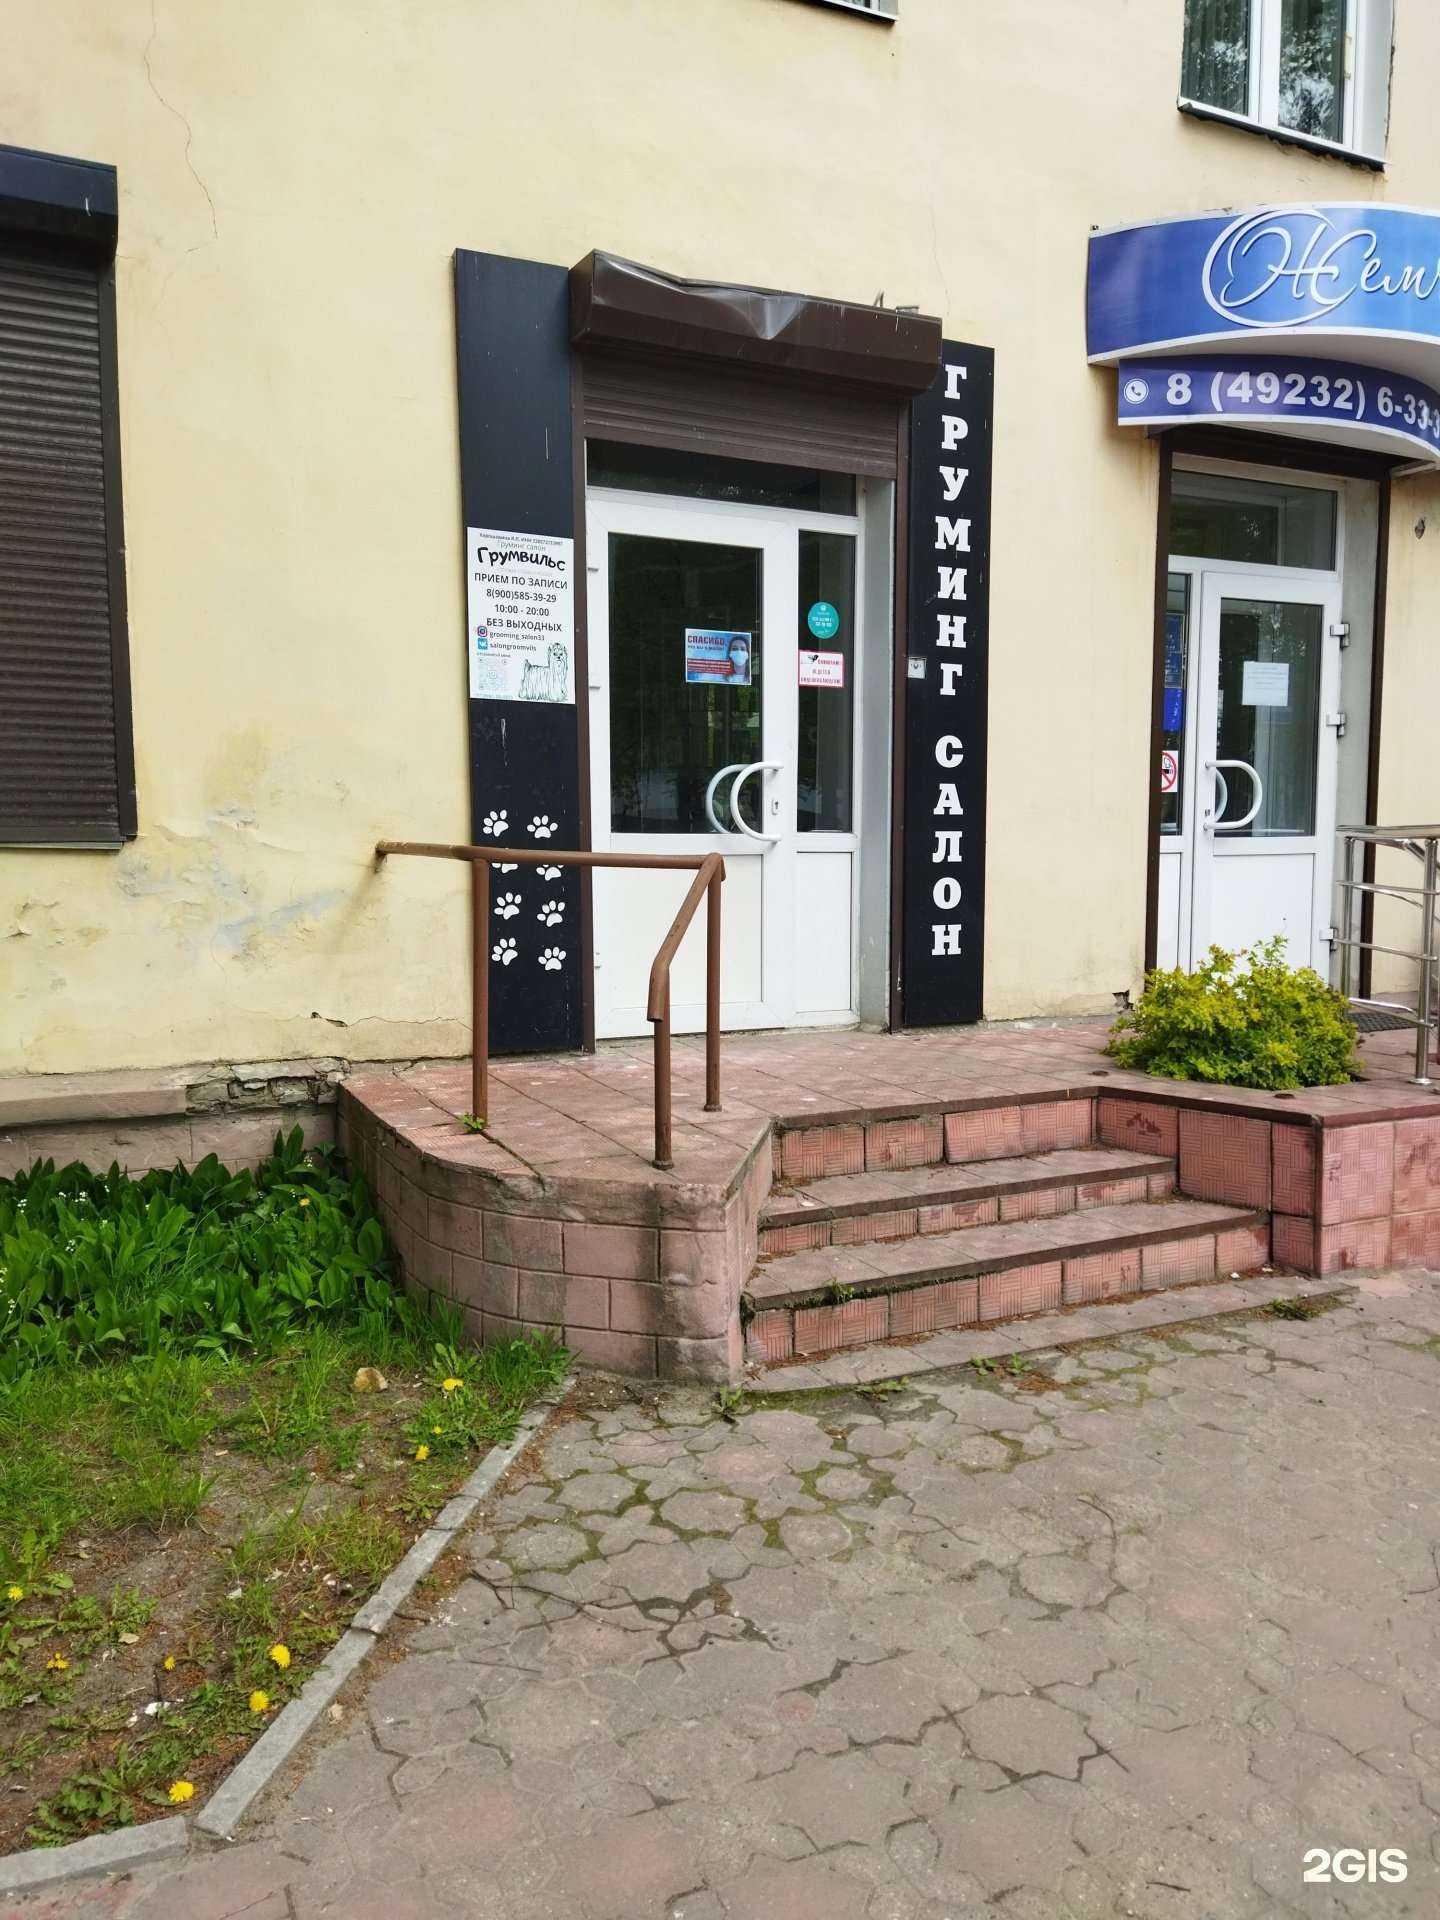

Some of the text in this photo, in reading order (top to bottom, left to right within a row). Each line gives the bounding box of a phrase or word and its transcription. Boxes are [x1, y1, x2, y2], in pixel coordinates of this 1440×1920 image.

[1165, 372, 1193, 406] 8
[1210, 370, 1367, 420] (49232)
[477, 546, 566, 571] Грумвильс
[474, 572, 509, 584] ПРИЕМ
[511, 576, 526, 586] ПО
[528, 578, 568, 589] ЗАПИСИ
[486, 588, 557, 603] 8(900)585-39-29
[495, 604, 518, 614] 10:00
[526, 607, 550, 616] 20:00
[486, 618, 562, 632] БЕЗ ВЫХОДНЫХ
[930, 364, 972, 957] ГРУМИНГ САЛОН
